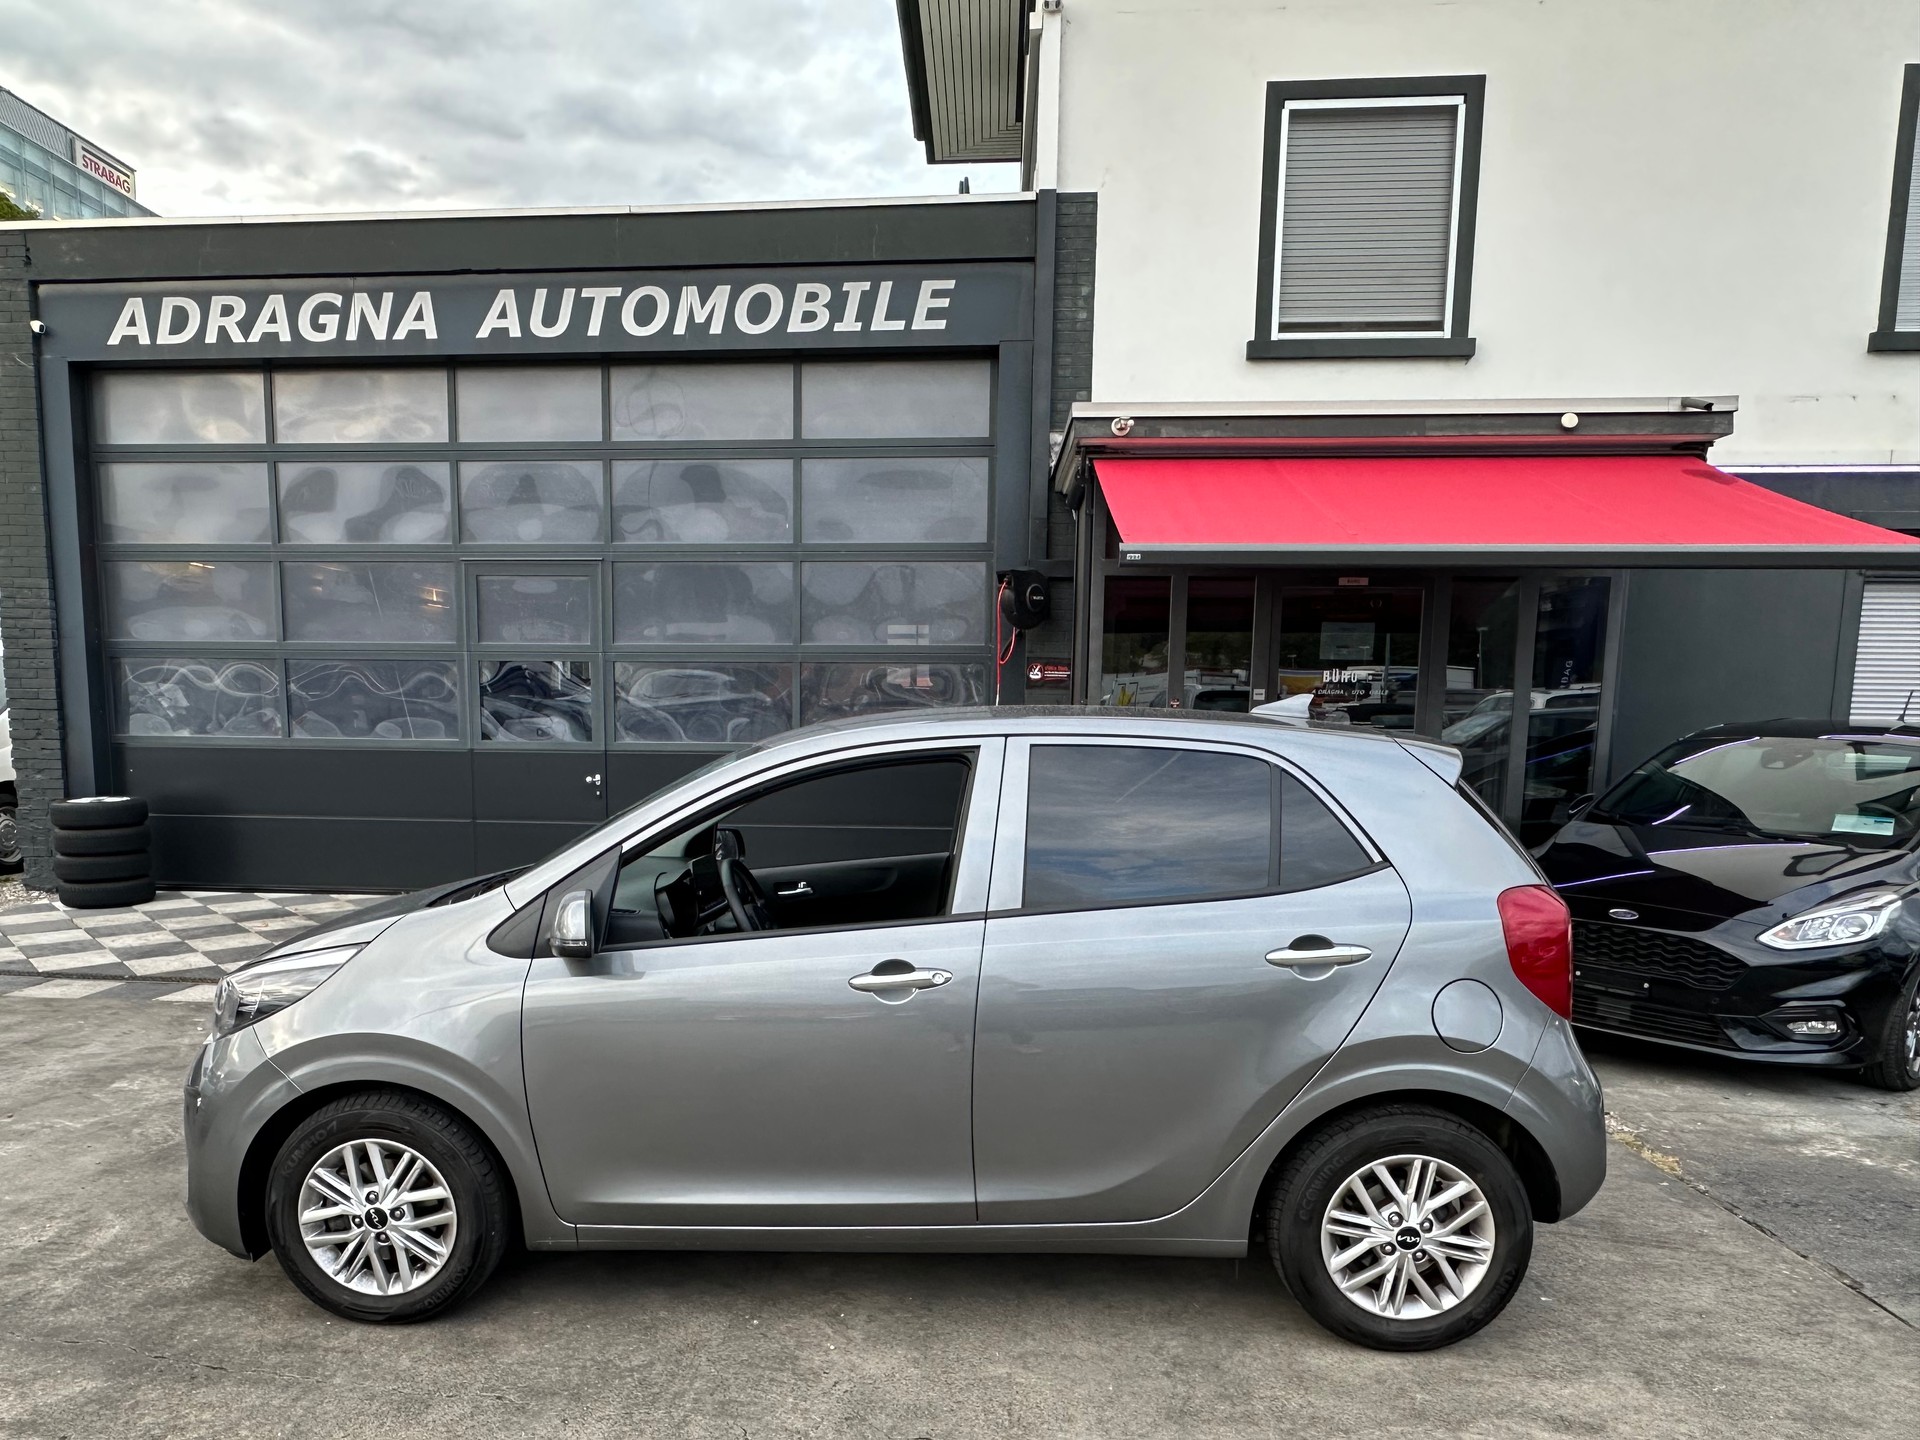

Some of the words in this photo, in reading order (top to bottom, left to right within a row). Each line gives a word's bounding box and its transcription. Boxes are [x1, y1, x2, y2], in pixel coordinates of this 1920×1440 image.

[82, 154, 131, 194] STRABAG
[106, 291, 438, 346] ADRAGNA
[475, 279, 957, 338] AUTOMOBILE
